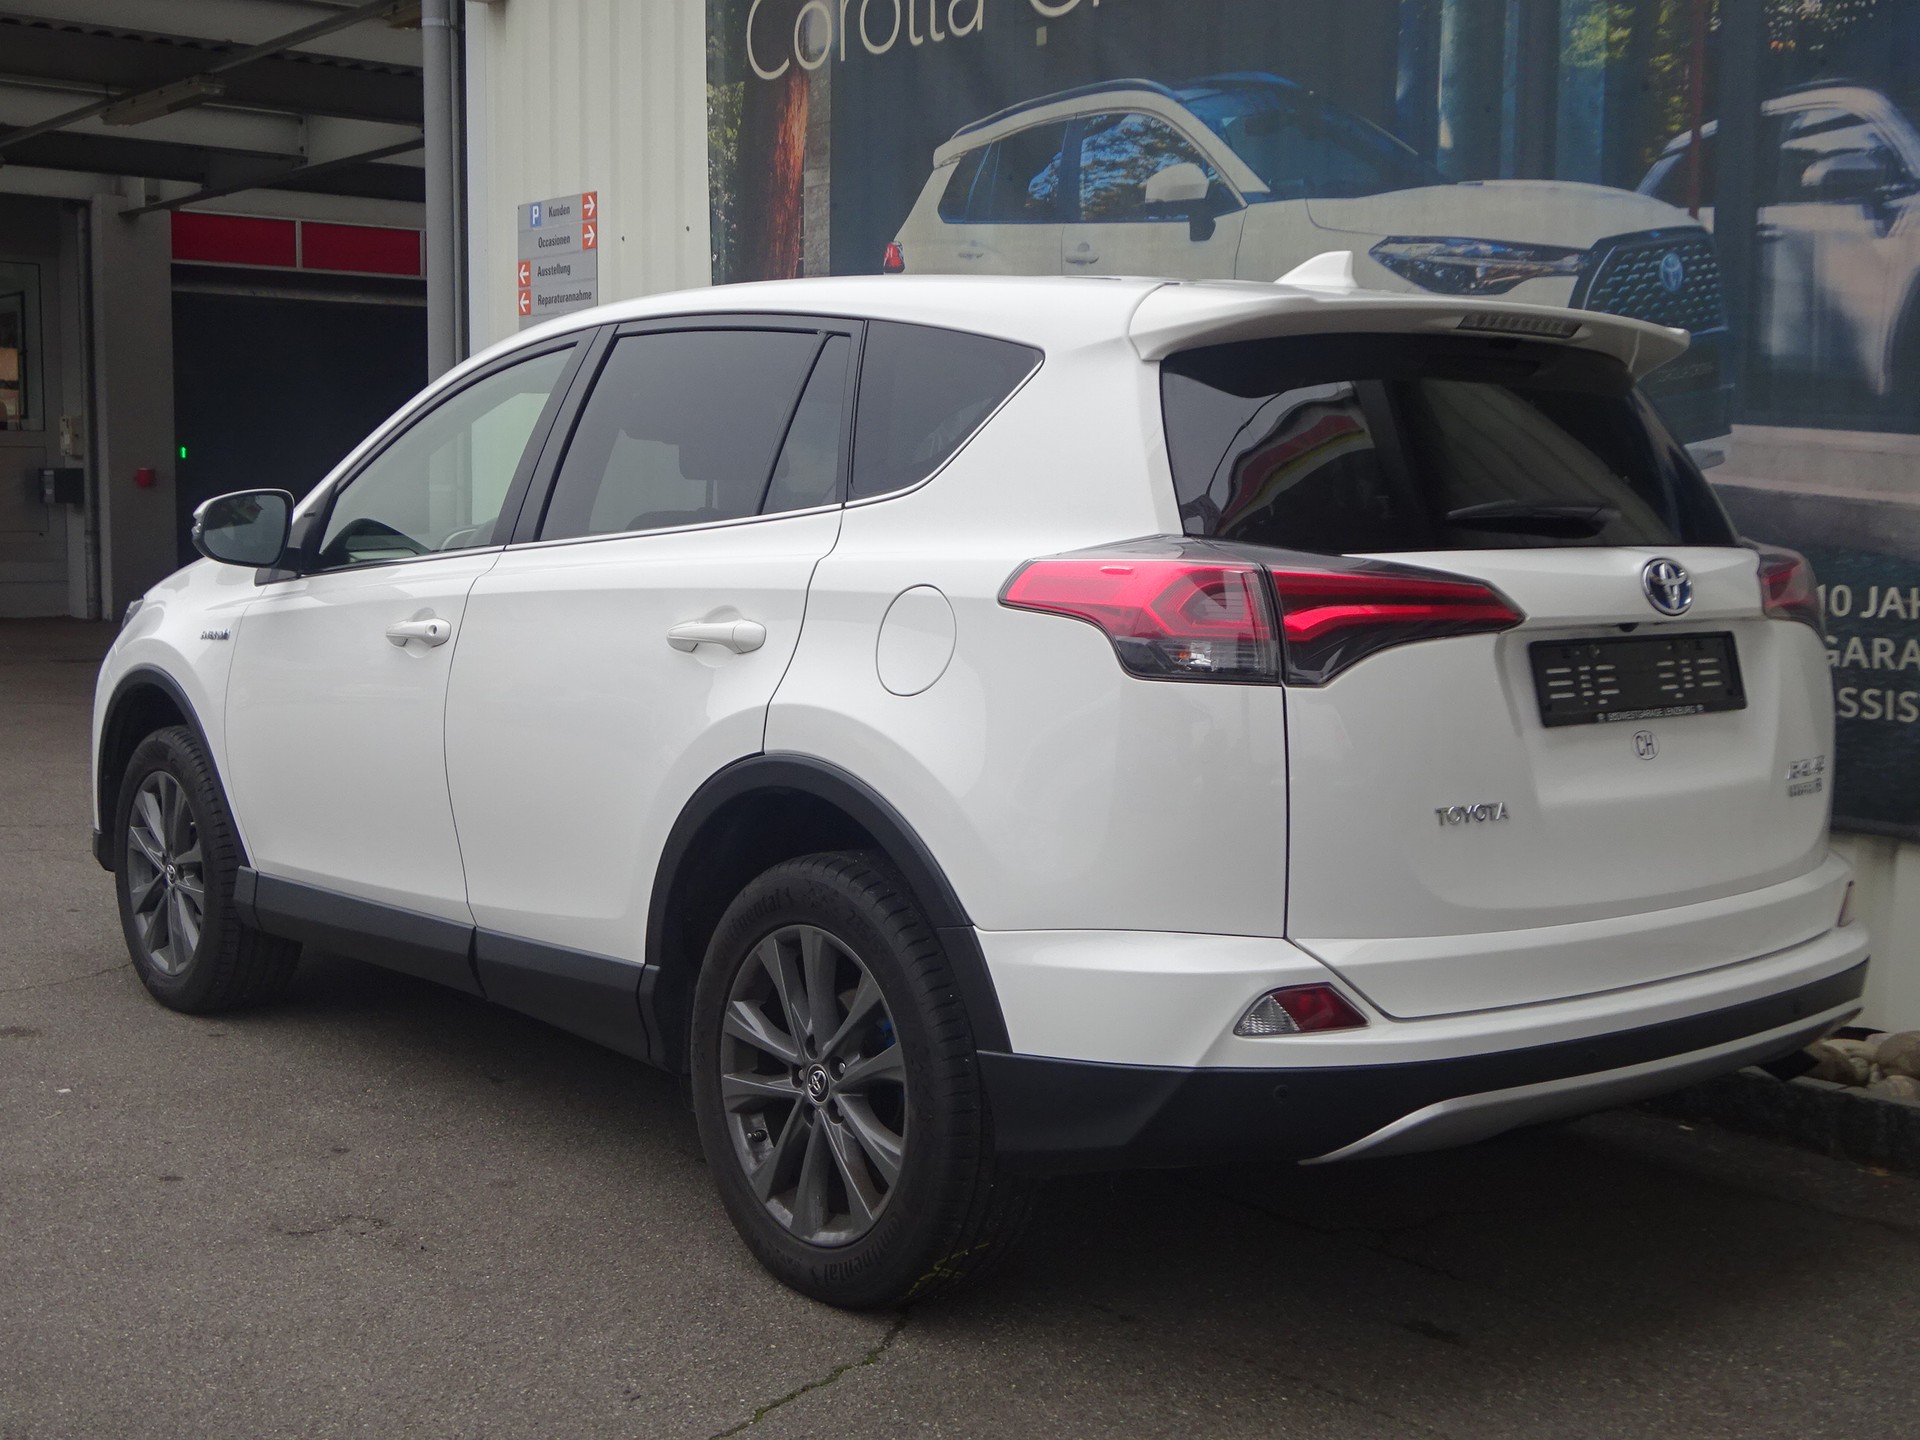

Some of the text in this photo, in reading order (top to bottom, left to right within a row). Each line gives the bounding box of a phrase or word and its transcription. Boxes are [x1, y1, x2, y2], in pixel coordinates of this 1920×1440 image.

[532, 204, 571, 225] P Kunden
[538, 234, 571, 248] Occasionen
[537, 263, 571, 277] Ausstellung
[537, 289, 592, 307] Reparaturannahme
[1634, 733, 1655, 756] CH
[1435, 802, 1509, 826] TOYOTA
